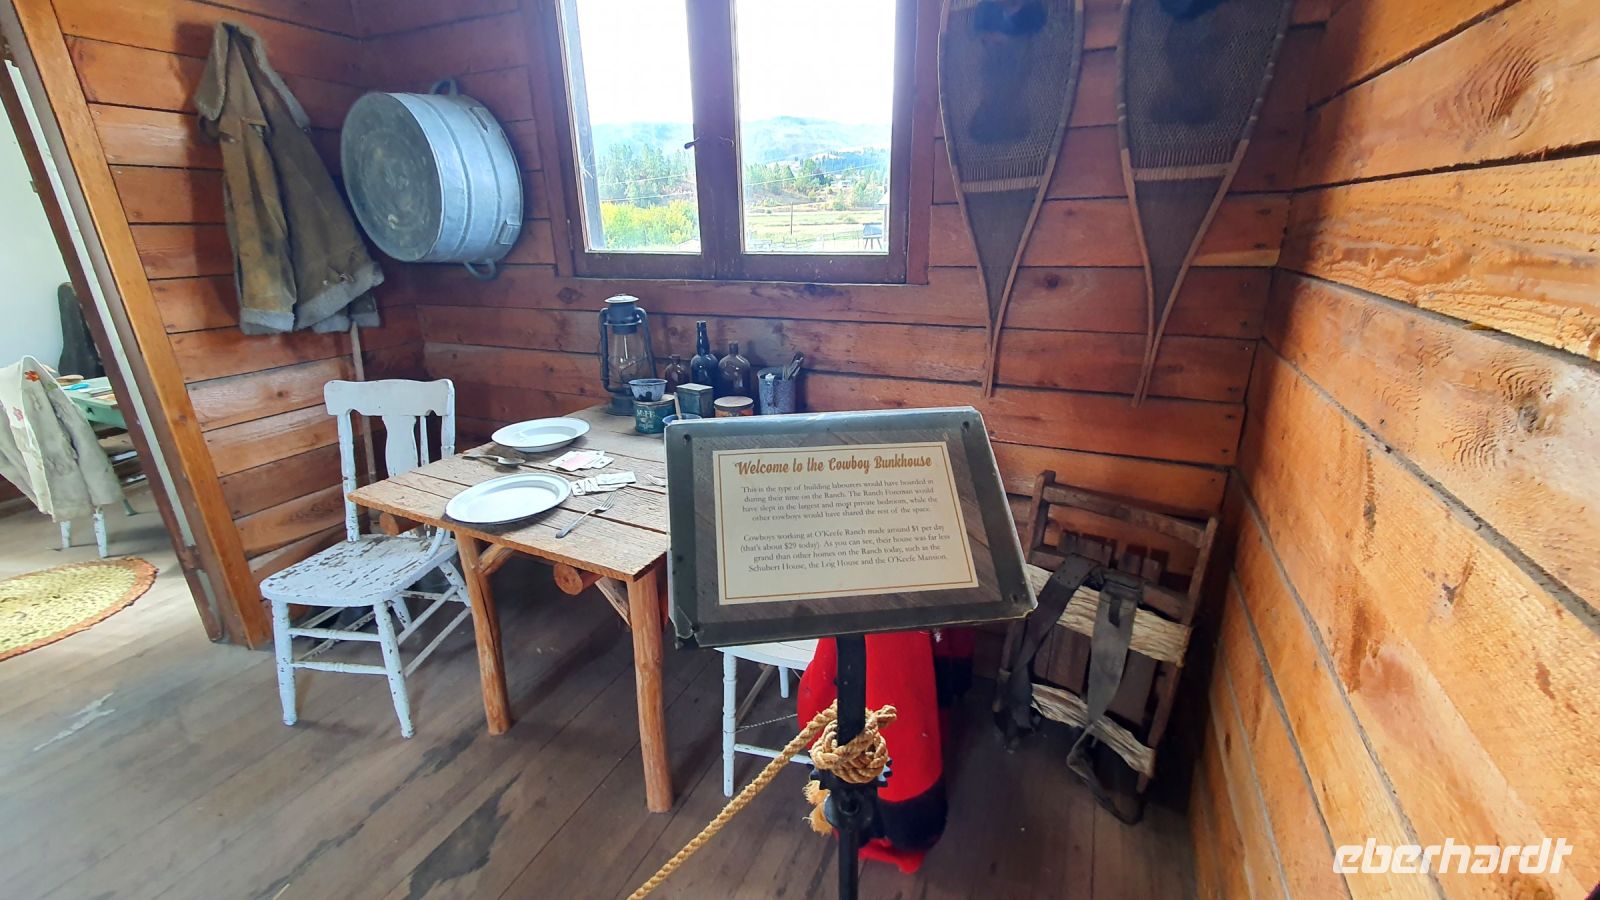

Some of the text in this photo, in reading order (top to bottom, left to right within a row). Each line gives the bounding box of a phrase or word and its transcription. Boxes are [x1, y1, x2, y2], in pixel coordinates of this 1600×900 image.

[735, 453, 932, 475] Welcome to the Cowboy Bunkhouse
[778, 485, 791, 493] type
[804, 483, 831, 492] building
[744, 496, 767, 504] during
[760, 505, 776, 513] slept
[798, 502, 820, 511] largest
[854, 500, 875, 508] private
[772, 513, 802, 522] cowboys
[744, 533, 776, 543] Cowboys
[777, 532, 805, 541] working
[934, 524, 944, 532] day
[740, 544, 761, 554] (that's
[753, 554, 774, 563] grand
[748, 564, 780, 572] Schubert
[821, 560, 836, 569] Log
